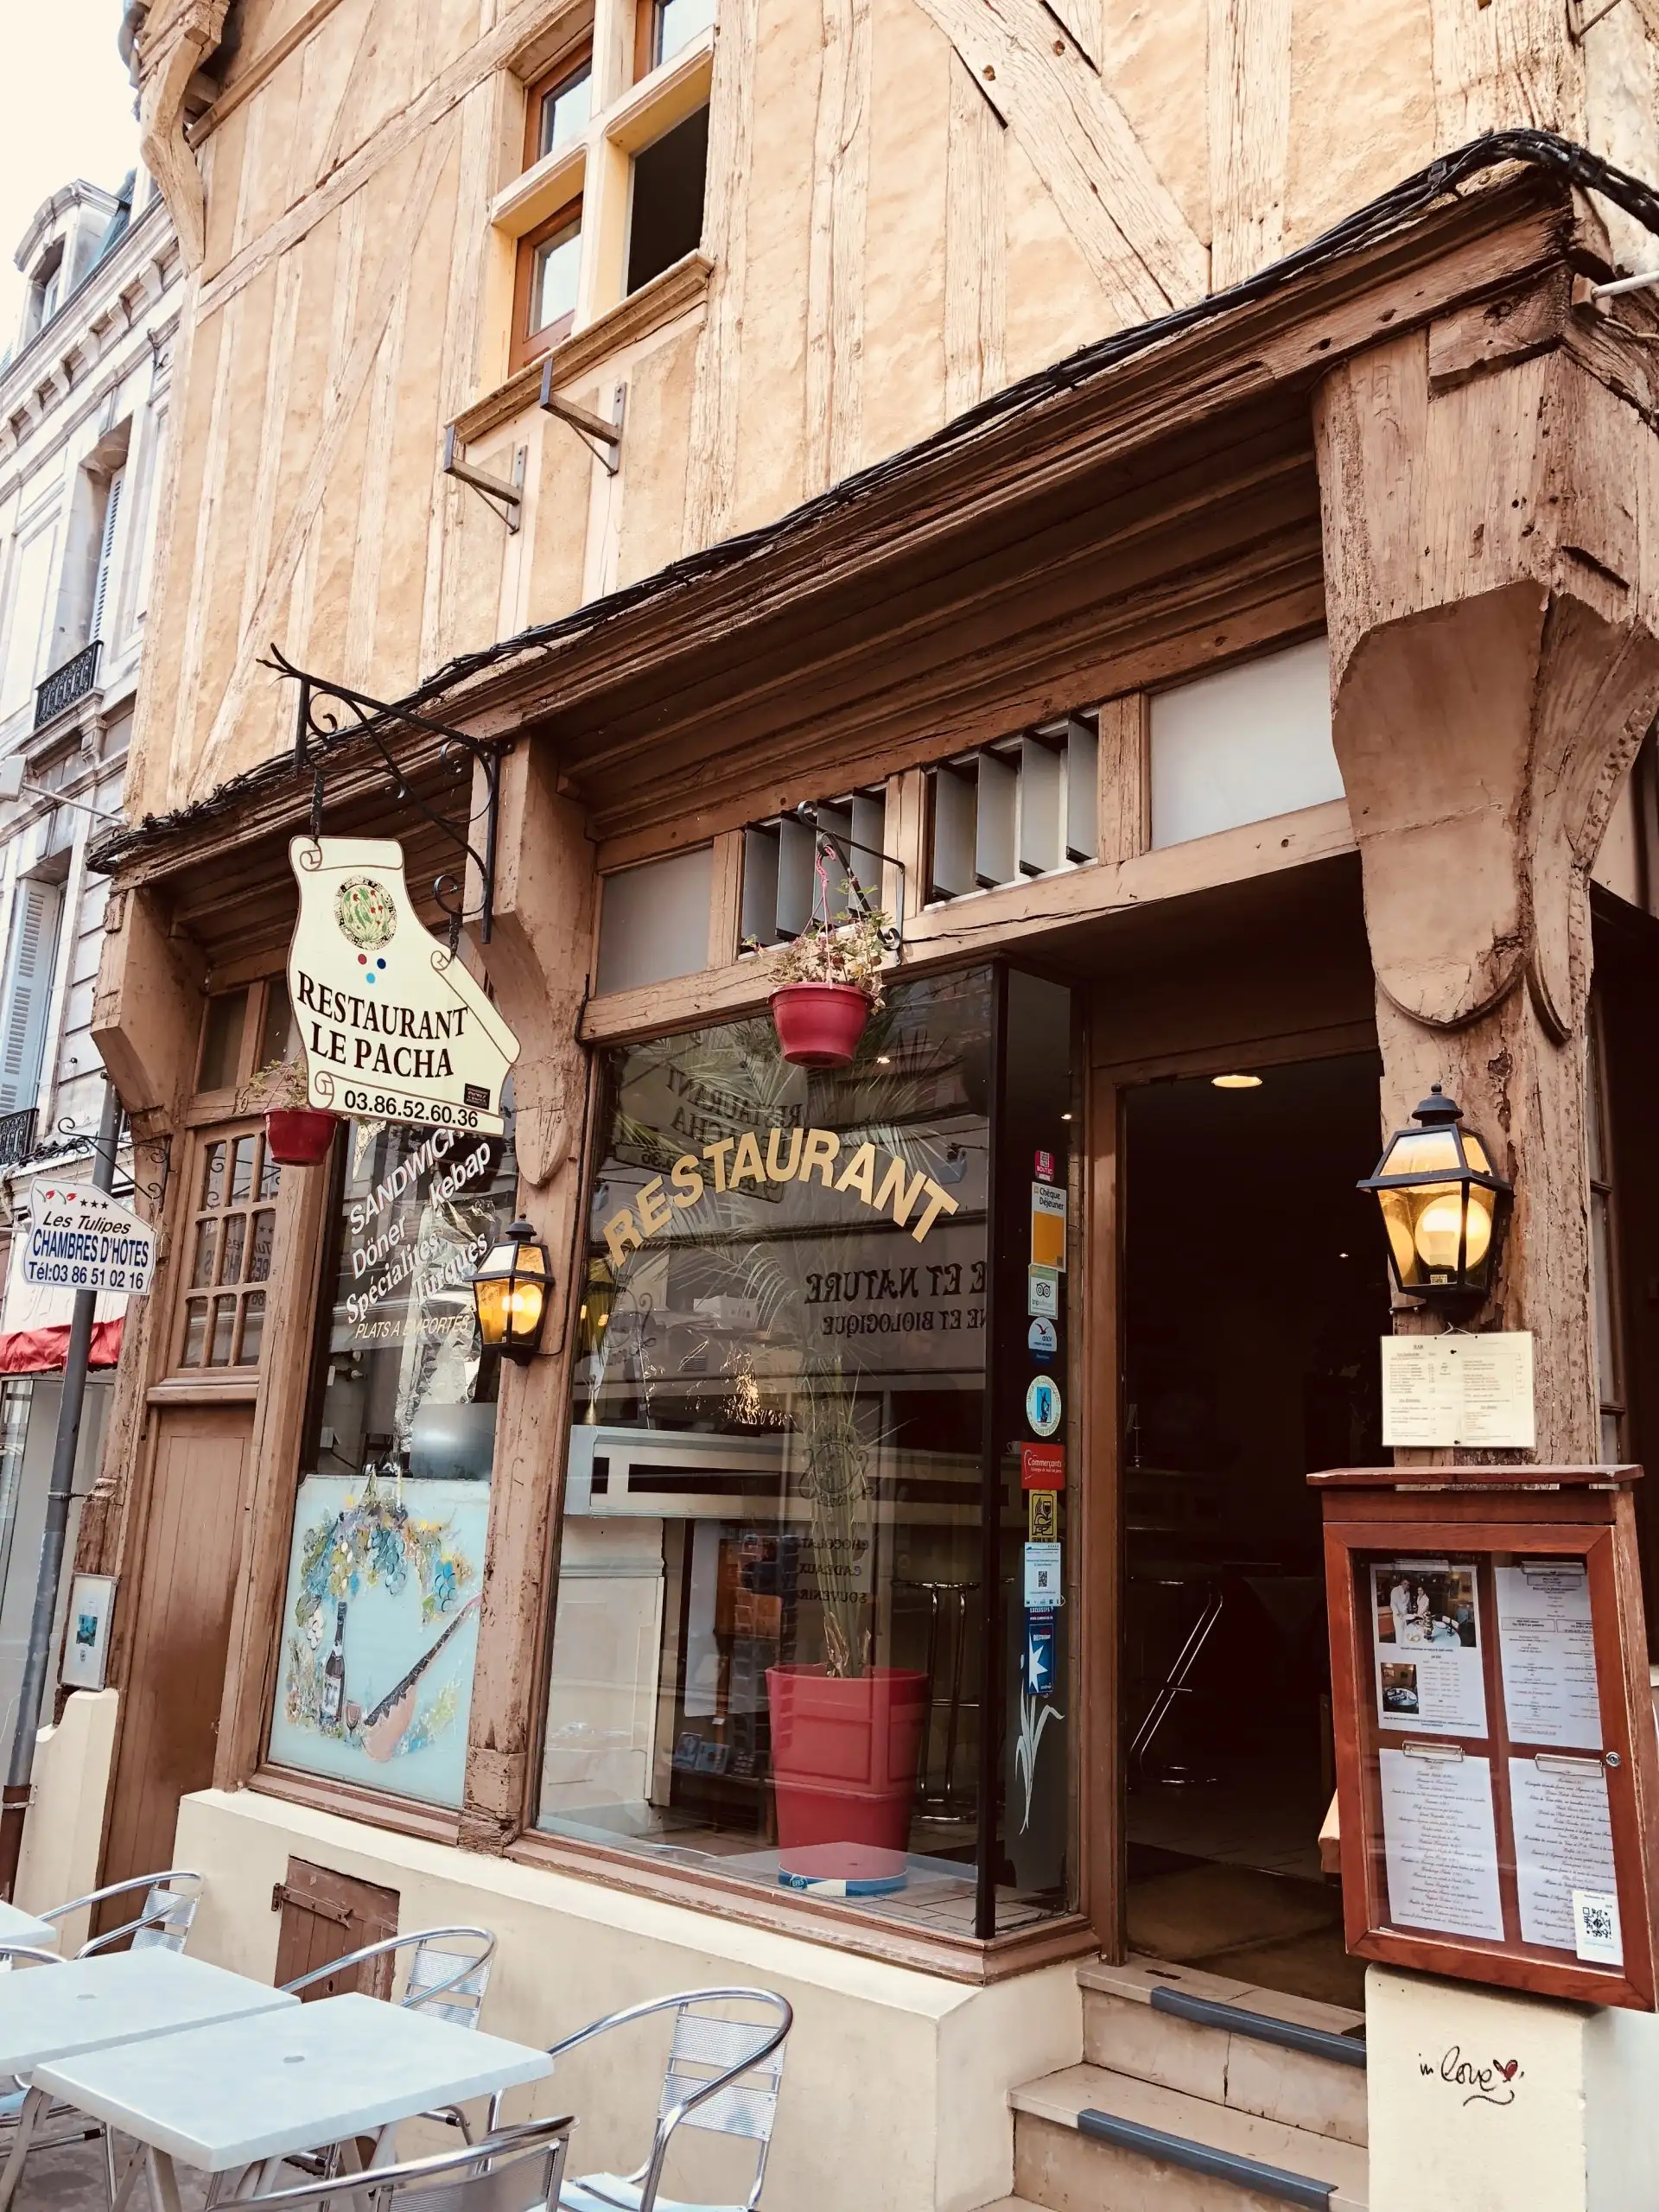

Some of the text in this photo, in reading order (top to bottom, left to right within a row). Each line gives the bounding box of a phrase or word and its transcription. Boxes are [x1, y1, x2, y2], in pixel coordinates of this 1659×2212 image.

[297, 970, 468, 1040] RESTAURANT
[310, 1021, 454, 1078] LE PACHA
[345, 1090, 478, 1128] 03.86.52.60.36
[602, 1128, 960, 1268] RESTAURANT
[1039, 1187, 1061, 1200] Chèque
[1039, 1197, 1064, 1210] Déjeuner
[43, 1211, 131, 1235] Les Tulipes
[353, 1141, 491, 1281] Döner kebap
[33, 1229, 97, 1262] CHAMBRES
[71, 1267, 87, 1283] 86
[90, 1268, 105, 1286] 51
[110, 1270, 124, 1287] 02
[130, 1272, 143, 1289] 16
[355, 1321, 391, 1339] PLATS
[391, 1321, 400, 1337] A
[1027, 1457, 1062, 1468] Commerçants
[1418, 2045, 1496, 2092] in love
